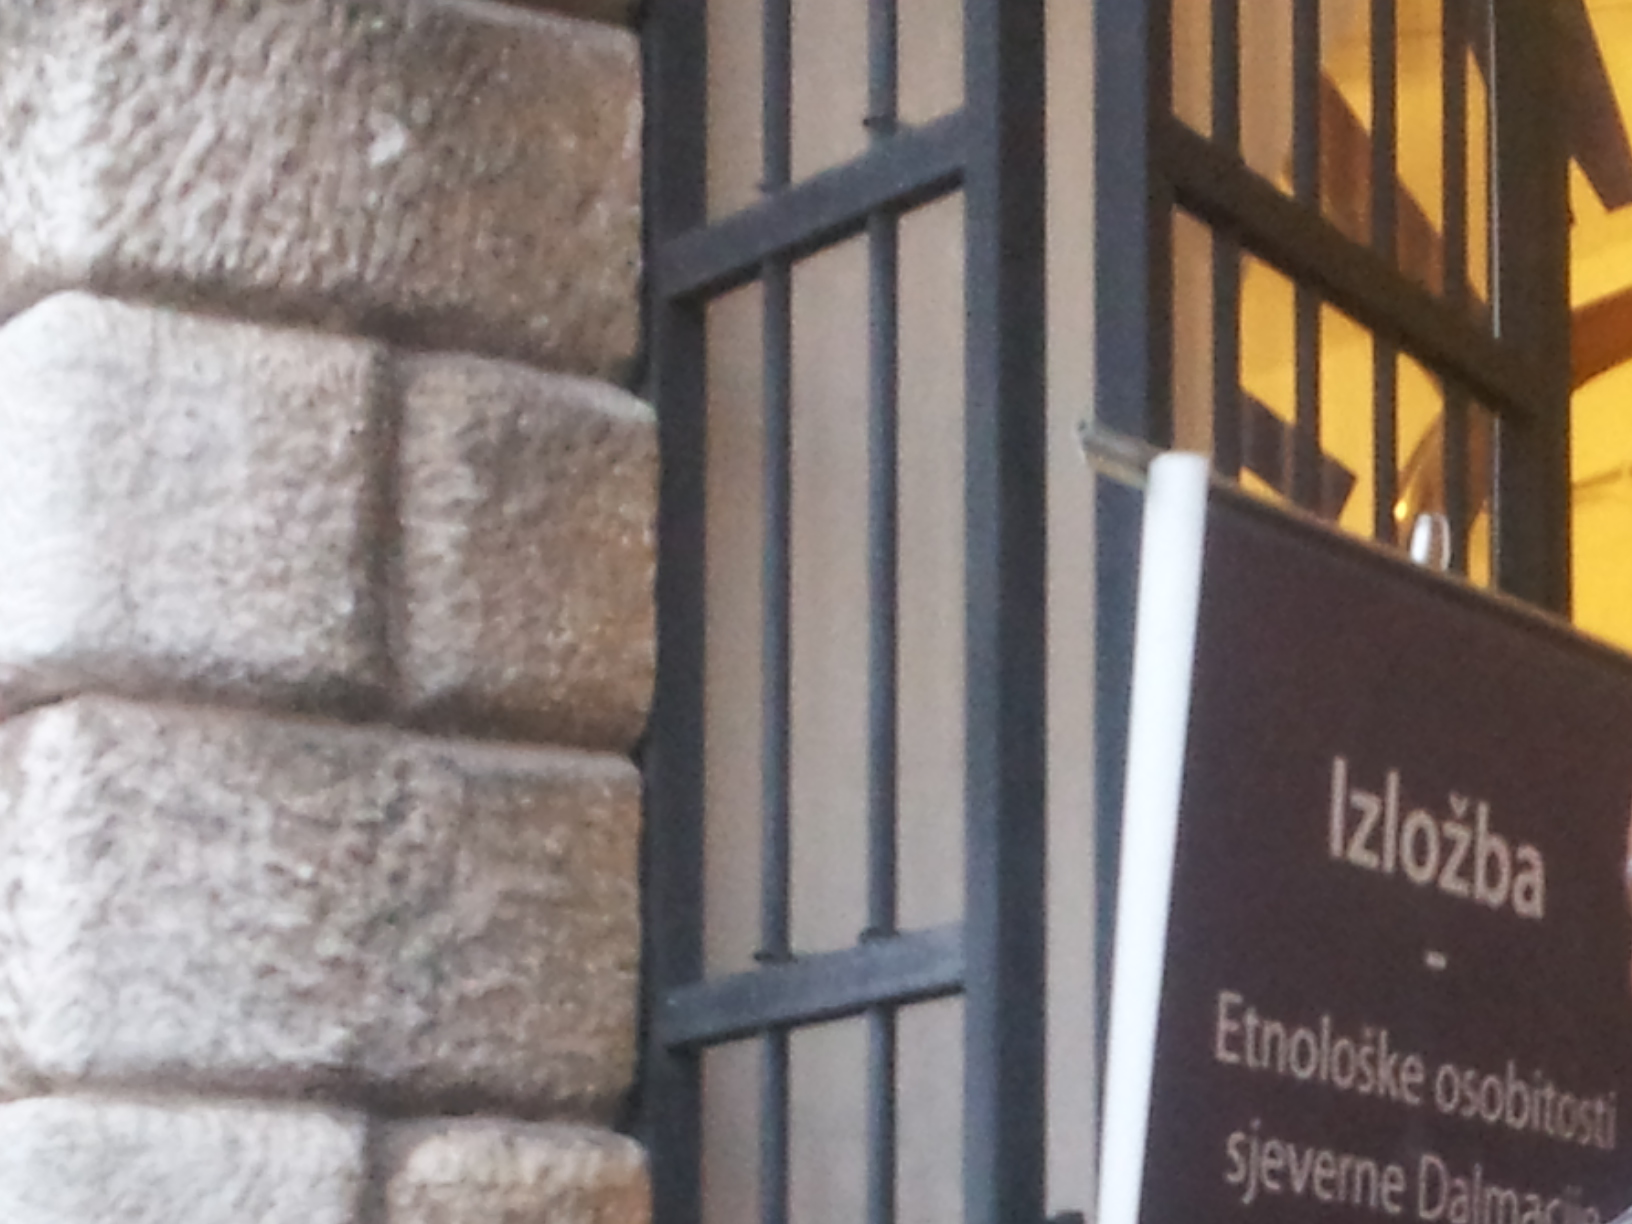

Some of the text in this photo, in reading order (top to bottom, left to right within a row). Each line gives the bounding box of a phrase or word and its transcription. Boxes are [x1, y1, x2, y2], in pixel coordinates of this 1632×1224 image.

[1328, 755, 1546, 919] Izložba
[1214, 991, 1618, 1150] Etnološke osobitosti
[1225, 1119, 1406, 1214] sjeverne
